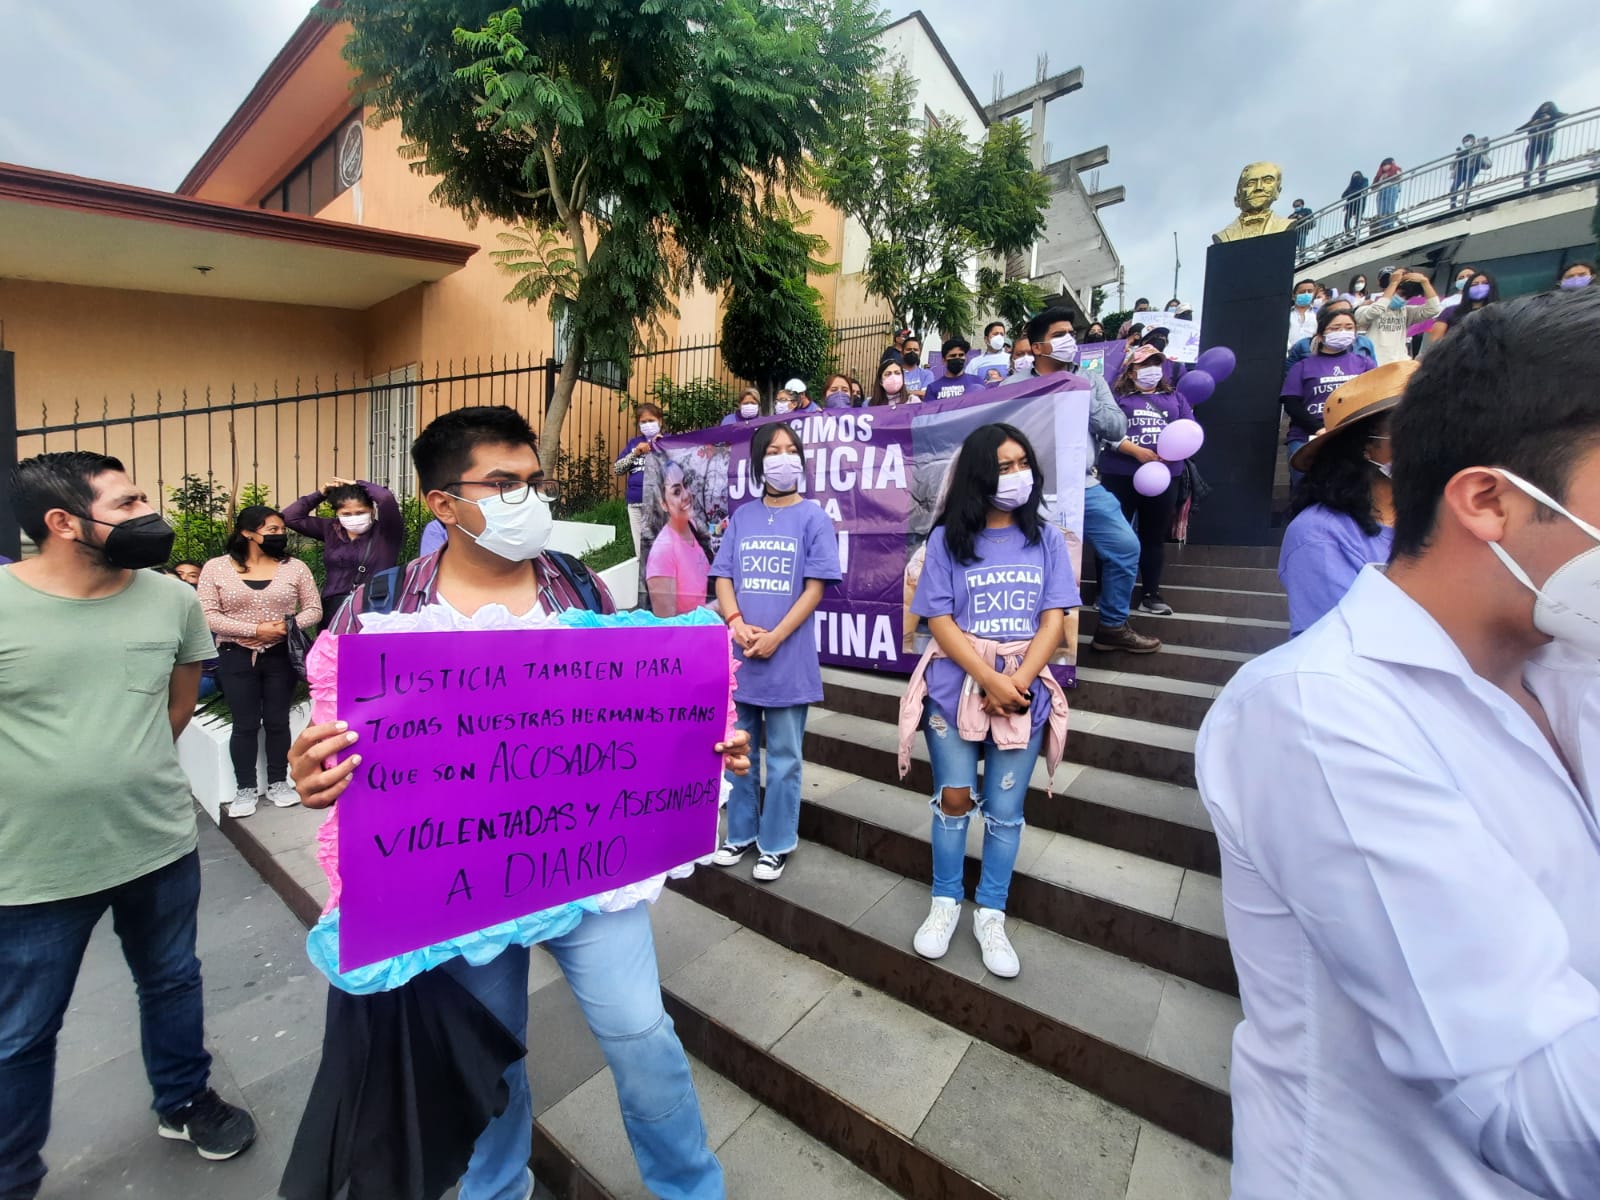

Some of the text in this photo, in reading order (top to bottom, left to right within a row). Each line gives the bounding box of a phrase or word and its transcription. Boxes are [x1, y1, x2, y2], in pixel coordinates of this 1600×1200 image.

[937, 388, 964, 400] JUSTIC
[1128, 417, 1168, 428] JUSTIC
[740, 540, 796, 553] TLAXCALA
[742, 556, 792, 575] EXIGE
[967, 570, 1042, 588] TLAXCALA
[974, 590, 1037, 614] EXIGE
[354, 652, 683, 702] JUSTICIA TAMBIEN PARA
[365, 704, 716, 743] TODAS NUESTRAS HERMANAS TRANS
[367, 740, 637, 792] QUE SON ACOSADAS
[374, 778, 718, 857] VIOLENTADAS Y ASESINADAS
[446, 835, 628, 905] A DIARIO
